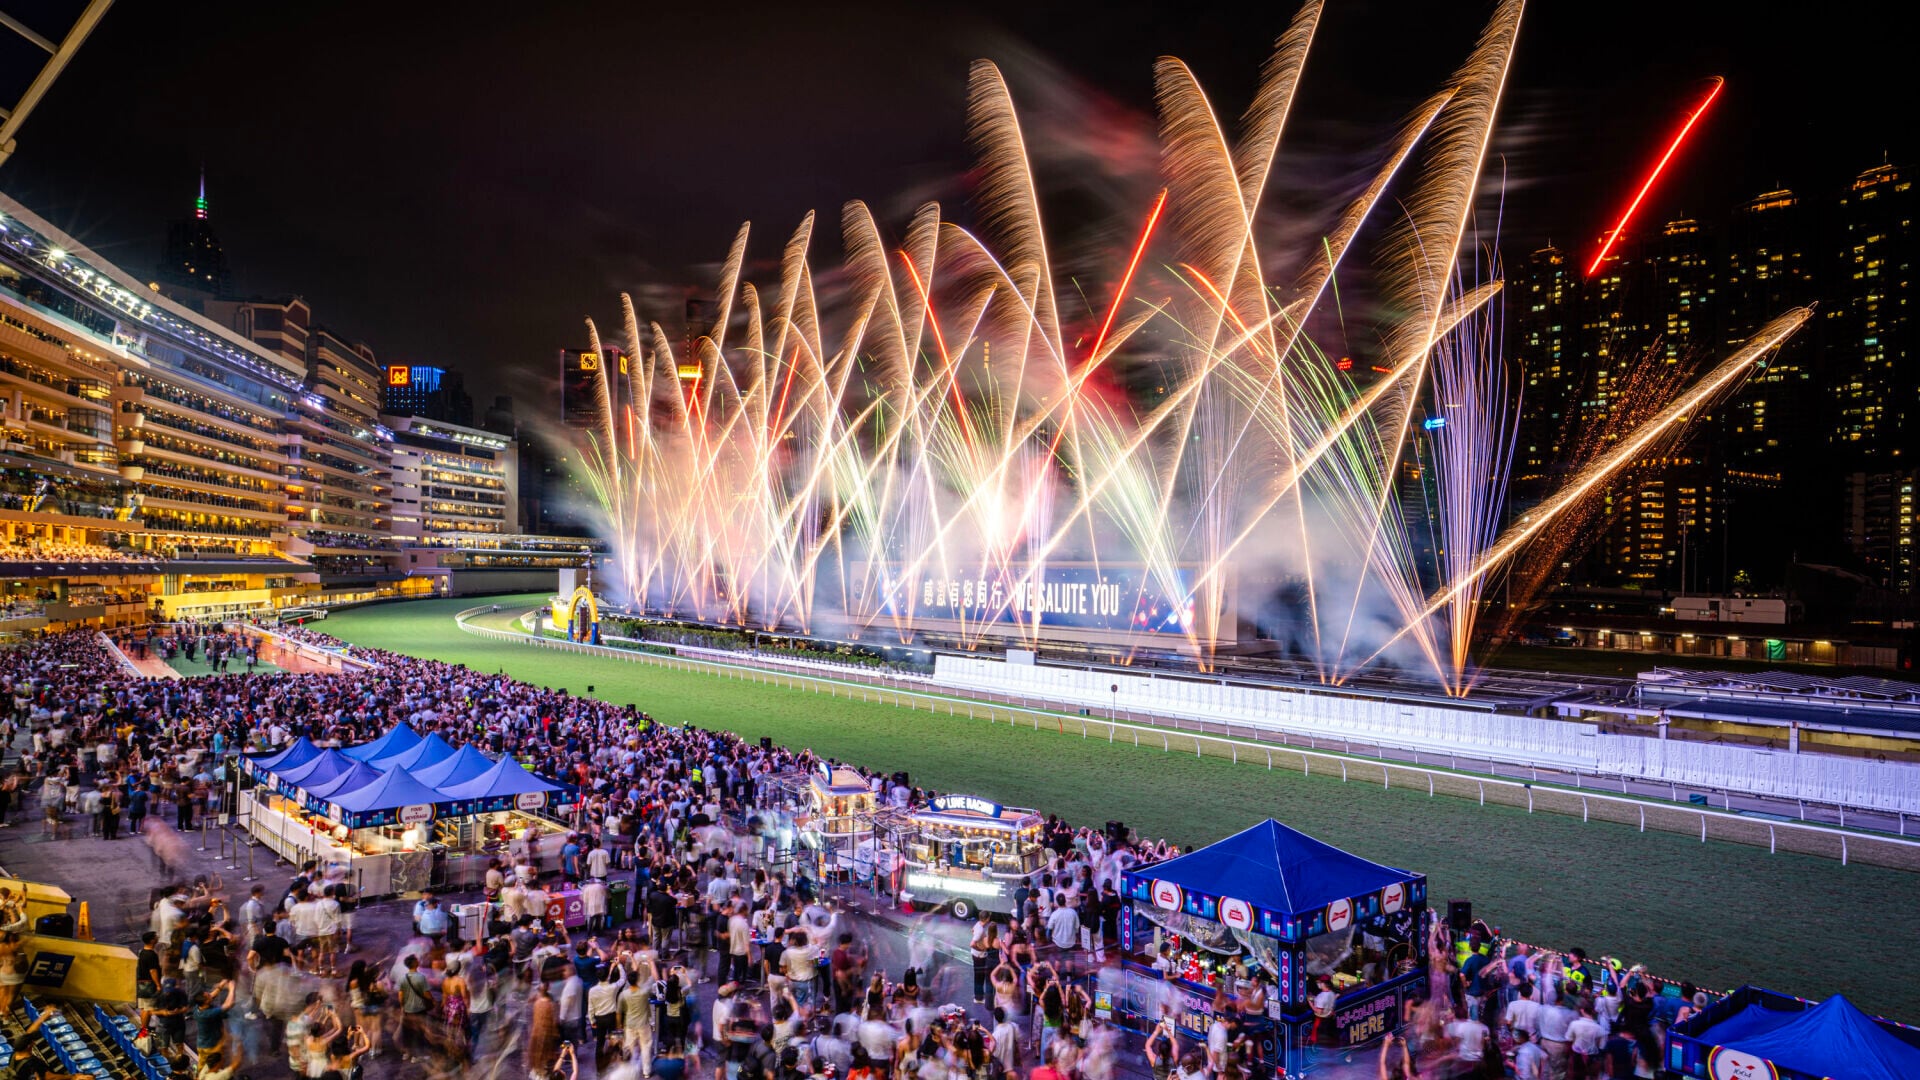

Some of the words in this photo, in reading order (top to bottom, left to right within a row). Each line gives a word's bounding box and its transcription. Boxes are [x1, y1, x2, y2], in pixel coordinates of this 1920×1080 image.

[1016, 583, 1034, 612] WE
[1038, 583, 1087, 615] SALUTE
[1092, 583, 1119, 616] YOU
[31, 960, 51, 977] E
[1350, 1013, 1385, 1044] HERE
